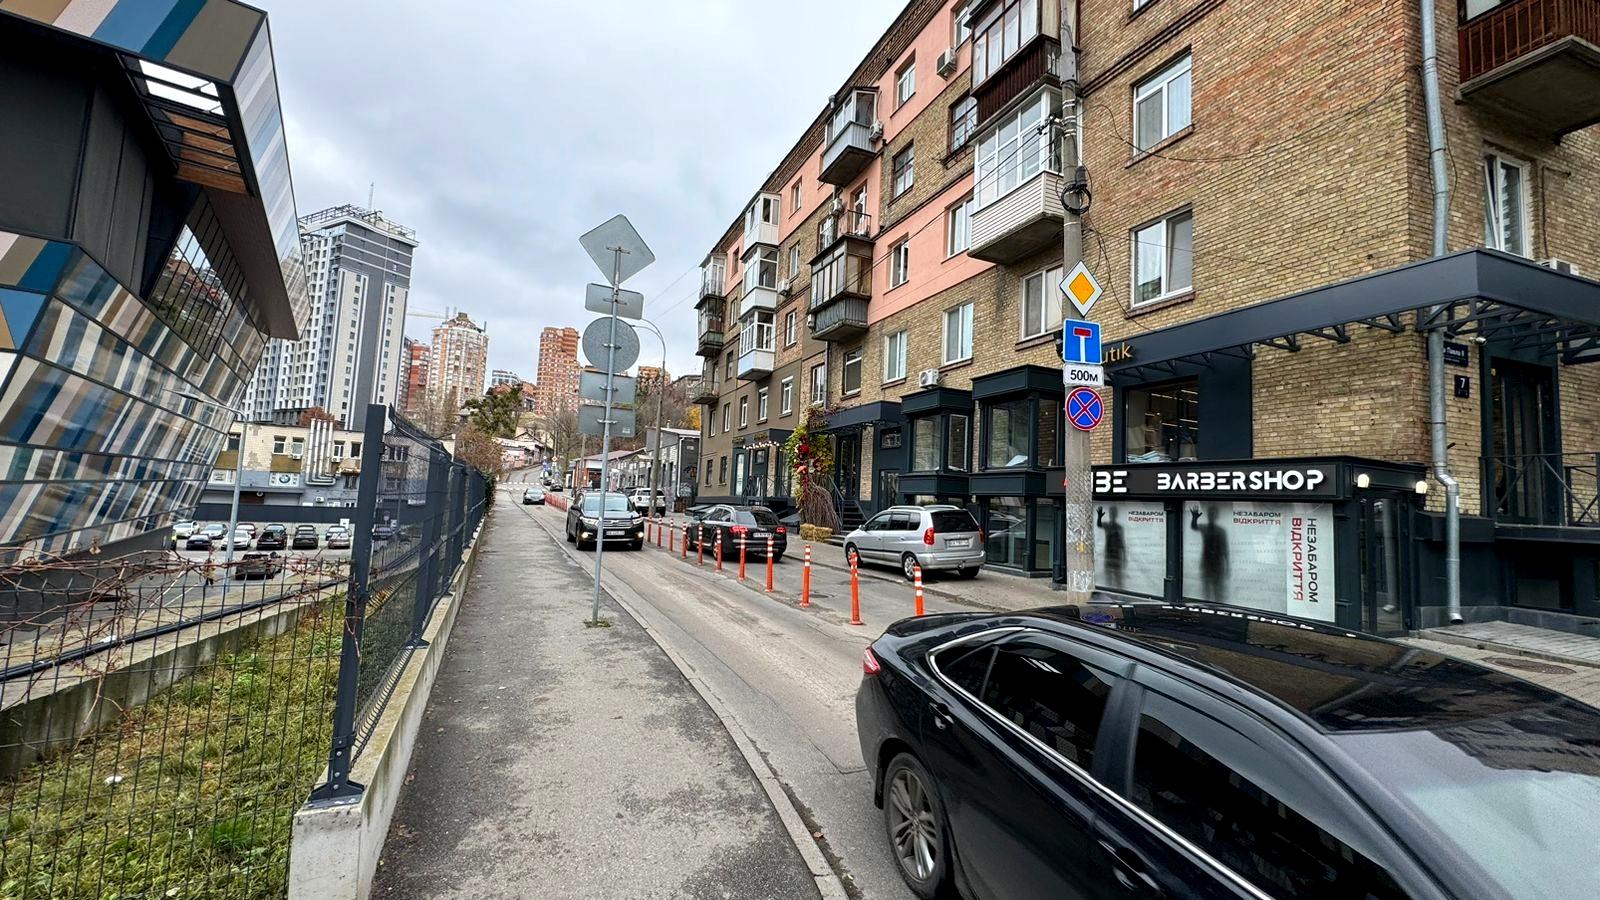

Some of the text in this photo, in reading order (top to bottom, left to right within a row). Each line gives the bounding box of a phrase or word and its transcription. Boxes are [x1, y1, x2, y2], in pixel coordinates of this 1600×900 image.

[1460, 378, 1466, 389] 7
[1157, 469, 1324, 491] BARBERSHOP
[1233, 517, 1281, 525] ВІДКРИТТЯ
[1291, 517, 1303, 601] ВІДКРИТТЯ
[1307, 518, 1318, 603] НЕЗАБАРОМ
